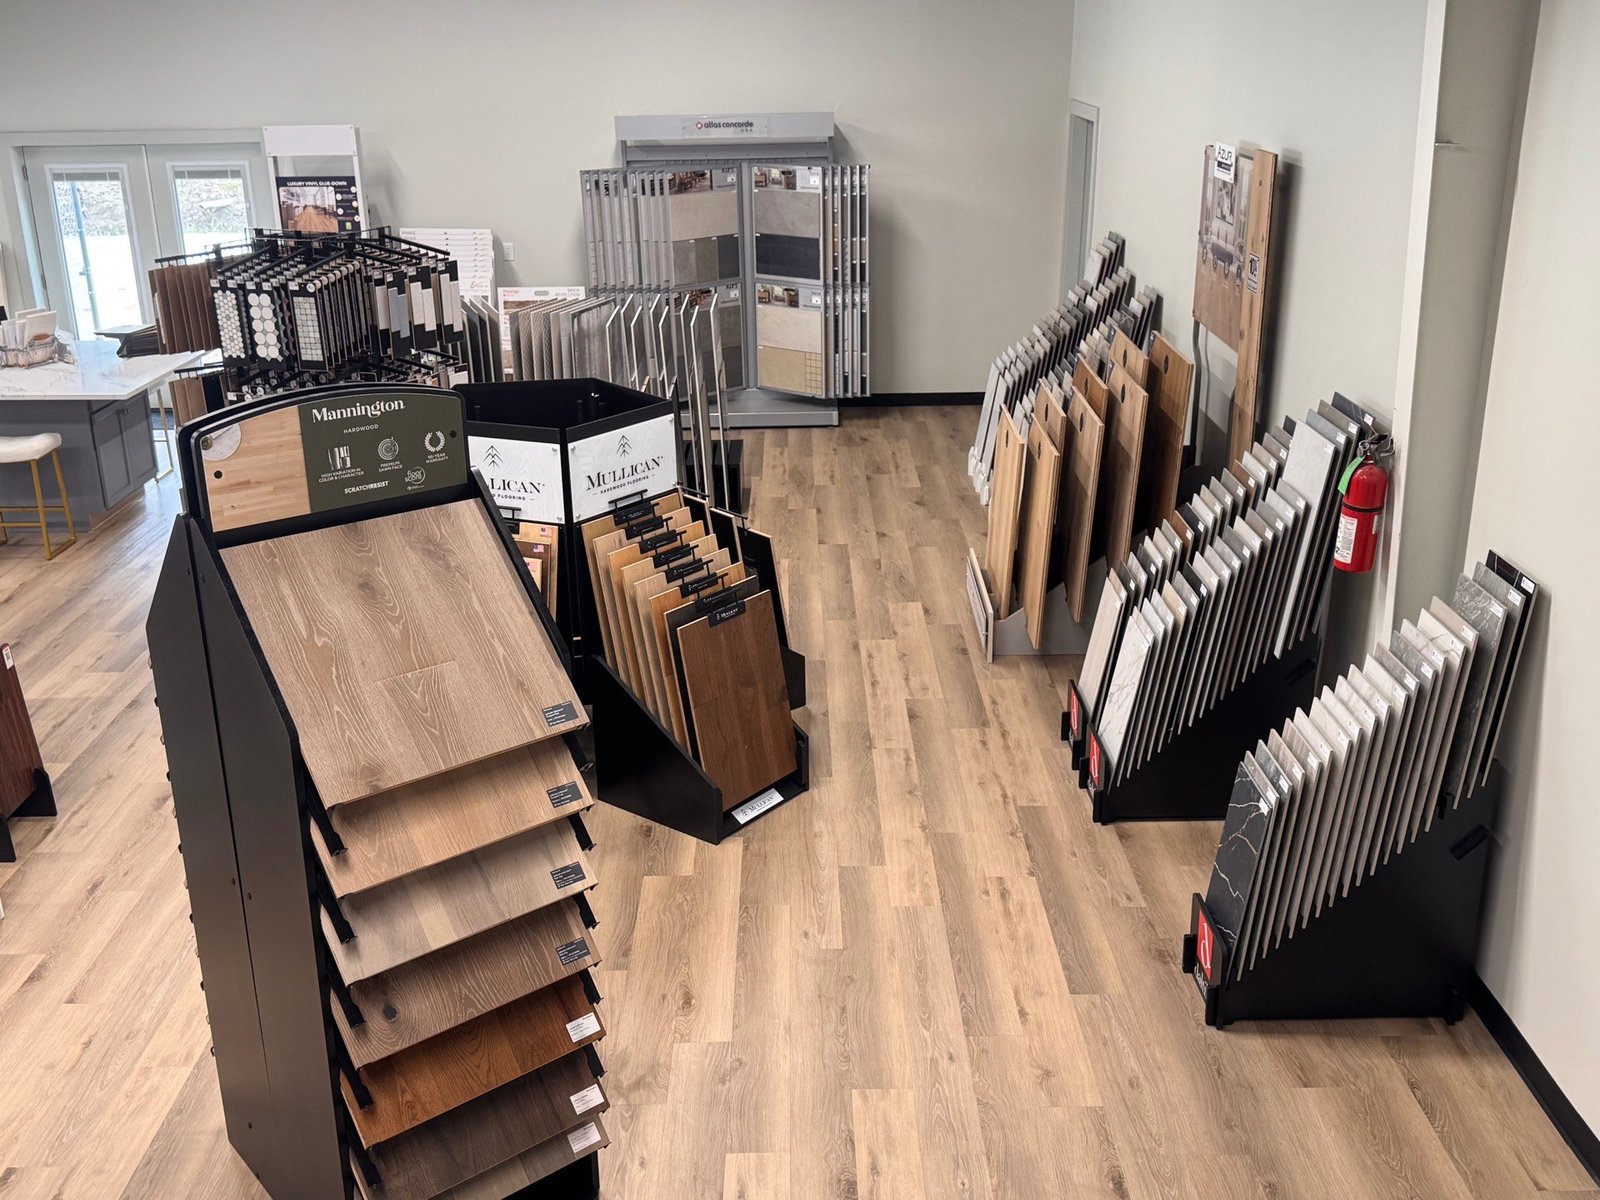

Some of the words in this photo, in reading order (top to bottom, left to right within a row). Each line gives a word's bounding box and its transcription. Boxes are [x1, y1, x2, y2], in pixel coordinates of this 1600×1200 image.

[722, 120, 753, 128] concorde
[312, 400, 404, 422] Mannington
[343, 424, 379, 434] HARDWOOD
[338, 471, 364, 479] CHARACTER
[586, 458, 660, 491] MULLICAN
[344, 480, 389, 494] SCRATCHRESIST
[487, 478, 541, 494] LICAN
[600, 483, 626, 494] HARDWOOD
[627, 475, 649, 485] FLOORING
[497, 493, 526, 501] FLOORING
